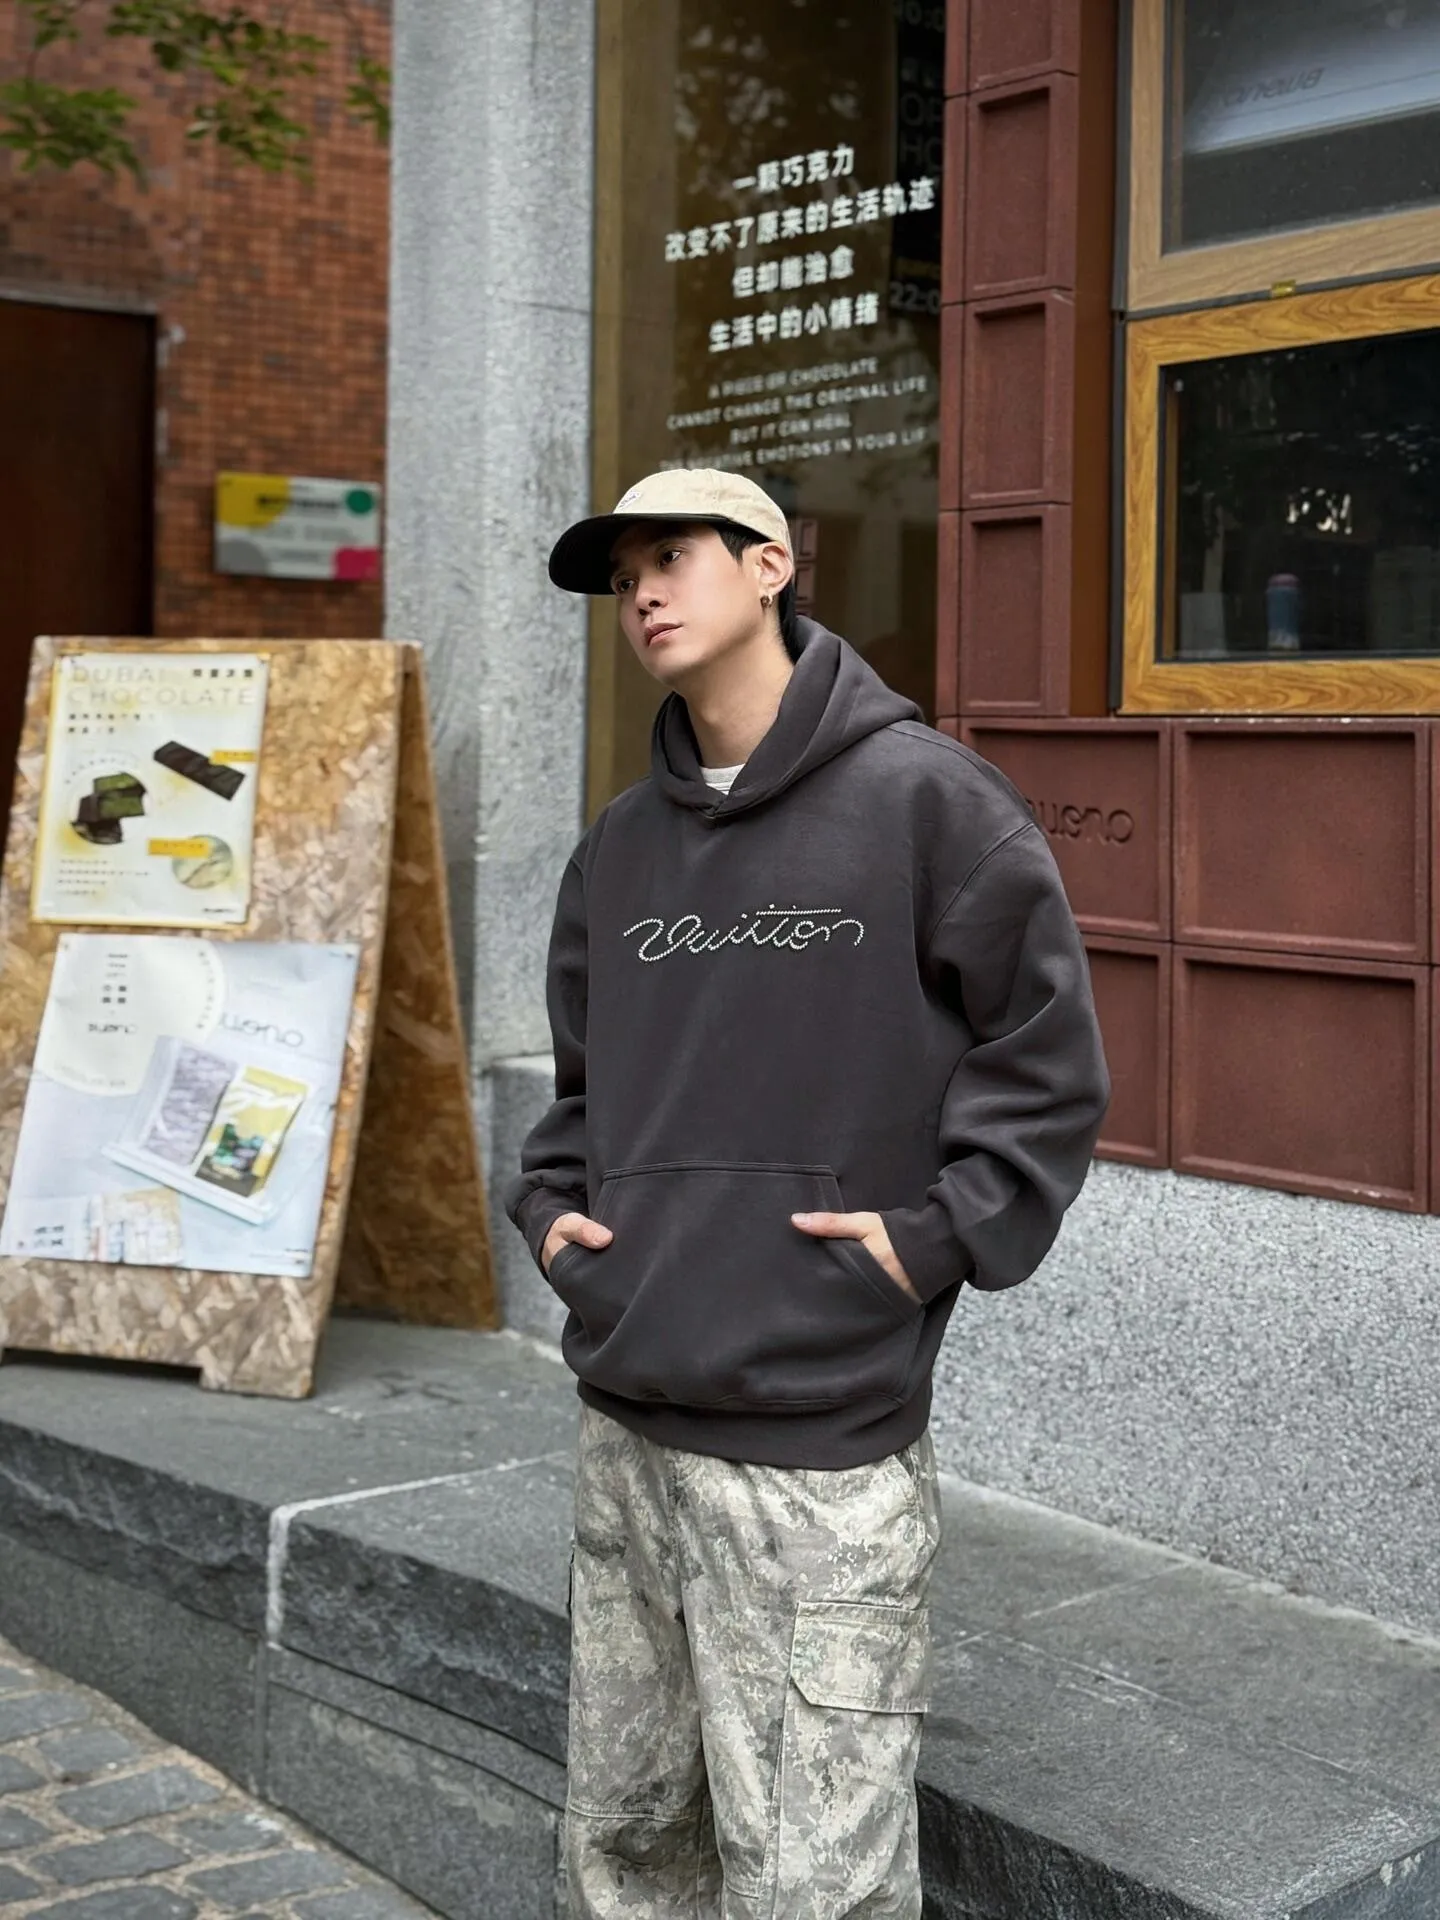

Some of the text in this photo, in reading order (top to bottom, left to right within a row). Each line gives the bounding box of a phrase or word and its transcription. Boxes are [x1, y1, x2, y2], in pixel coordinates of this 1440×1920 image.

[733, 143, 854, 192] 一颗巧克力
[665, 176, 935, 261] 改变不了原来的生活轨迹
[708, 292, 878, 352] 生活中的小情绪
[789, 357, 878, 386] CHOCOLATE
[666, 375, 927, 431] CANNOT CHANGE THE ORIGINAL LIFE
[730, 424, 759, 444] BUT
[761, 421, 776, 438] IT
[778, 419, 810, 437] CAN
[756, 440, 831, 465] EMOTIONS
[834, 438, 852, 452] IN
[856, 431, 897, 450] YOUR
[66, 686, 256, 706] CHOCOLATE
